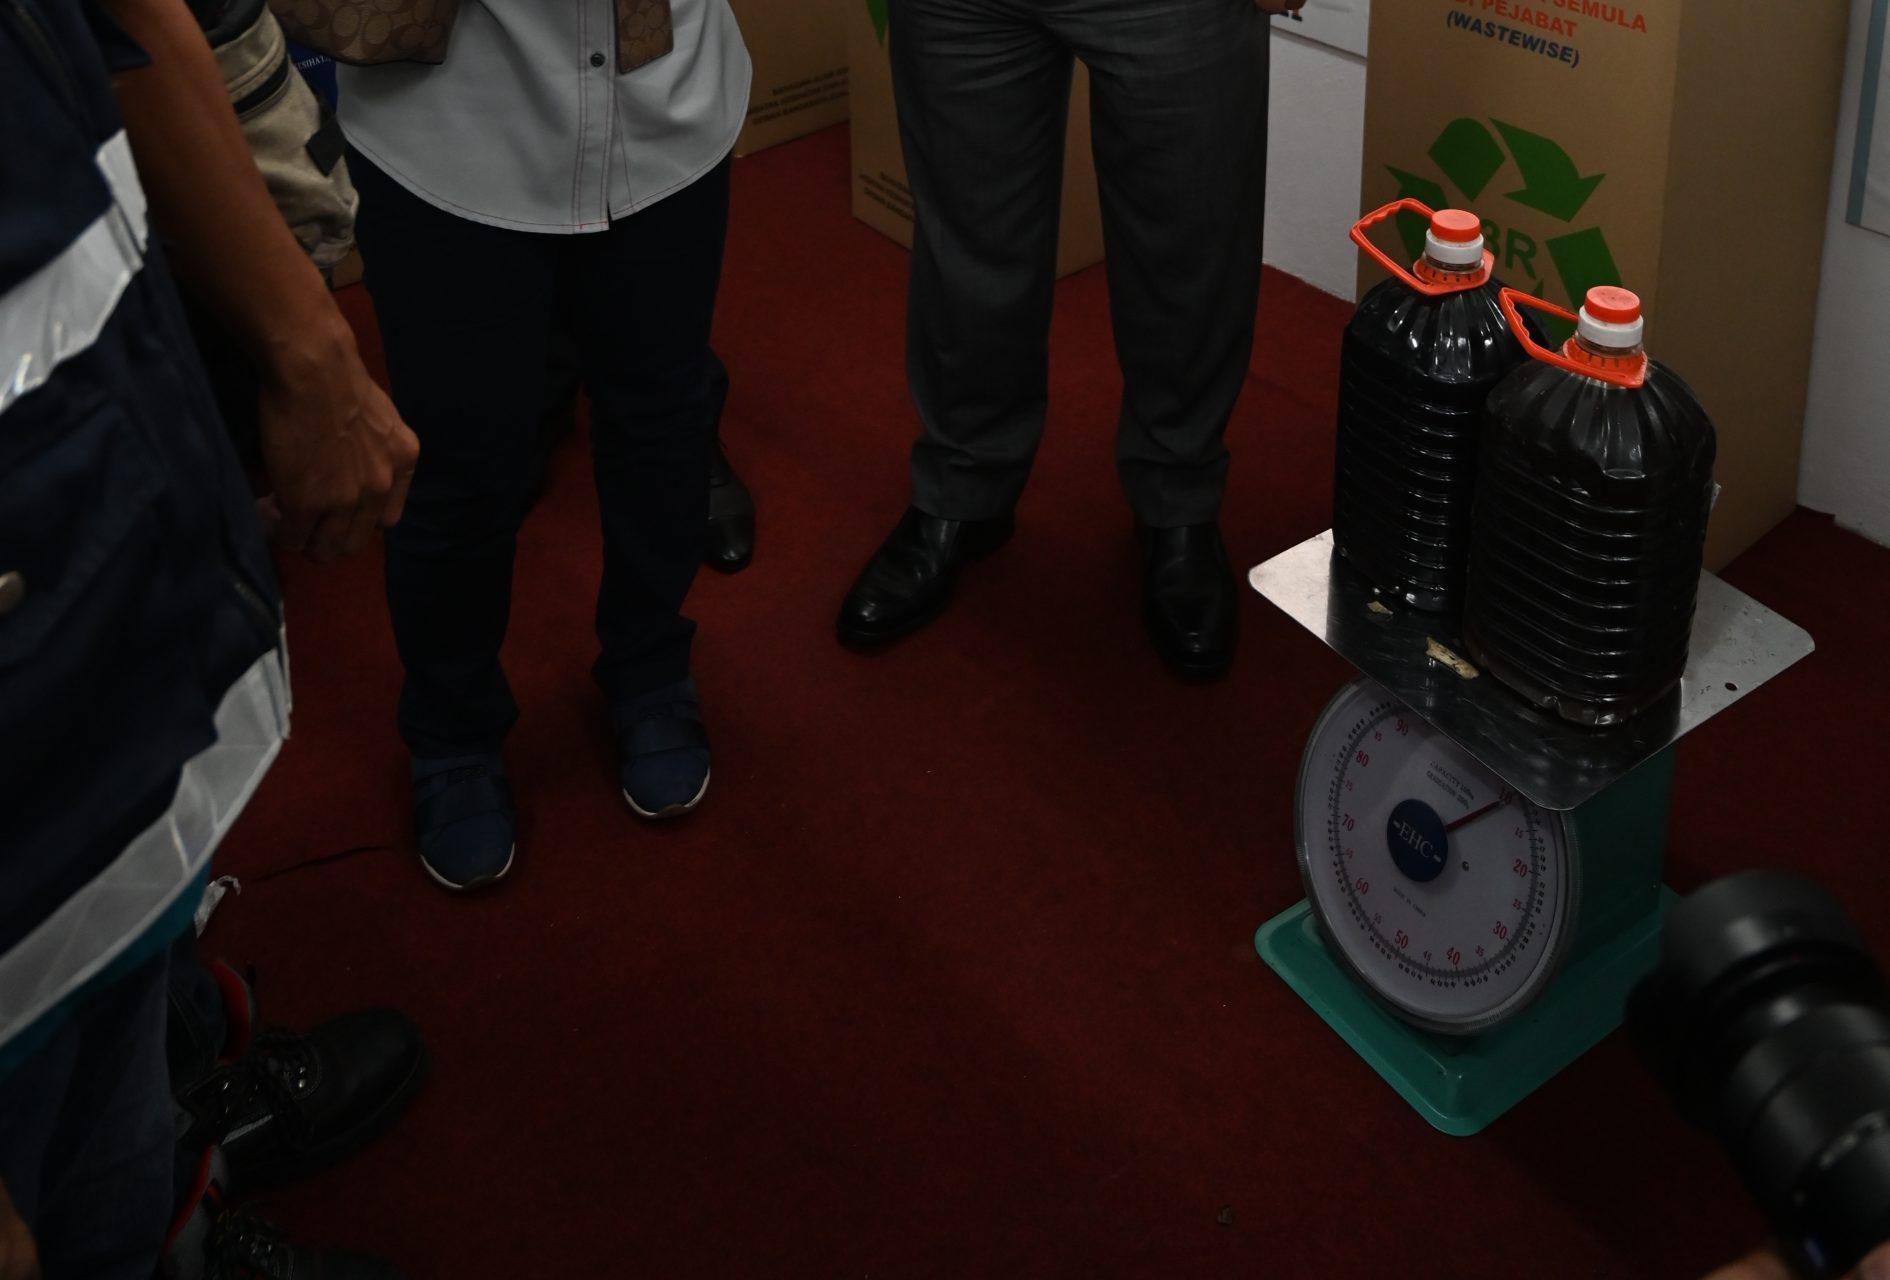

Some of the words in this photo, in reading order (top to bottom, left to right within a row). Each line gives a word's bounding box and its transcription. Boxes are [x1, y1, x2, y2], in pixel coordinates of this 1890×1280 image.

[1447, 9, 1580, 68] (WASTEWISE)
[1396, 719, 1409, 736] 90
[1356, 750, 1369, 767] 80
[1342, 814, 1354, 831] 70
[1400, 822, 1434, 858] EHC
[1513, 858, 1527, 877] 20
[1356, 877, 1369, 895] 60
[1493, 920, 1507, 939] 30
[1394, 929, 1408, 949] 50
[1446, 947, 1460, 965] 40
